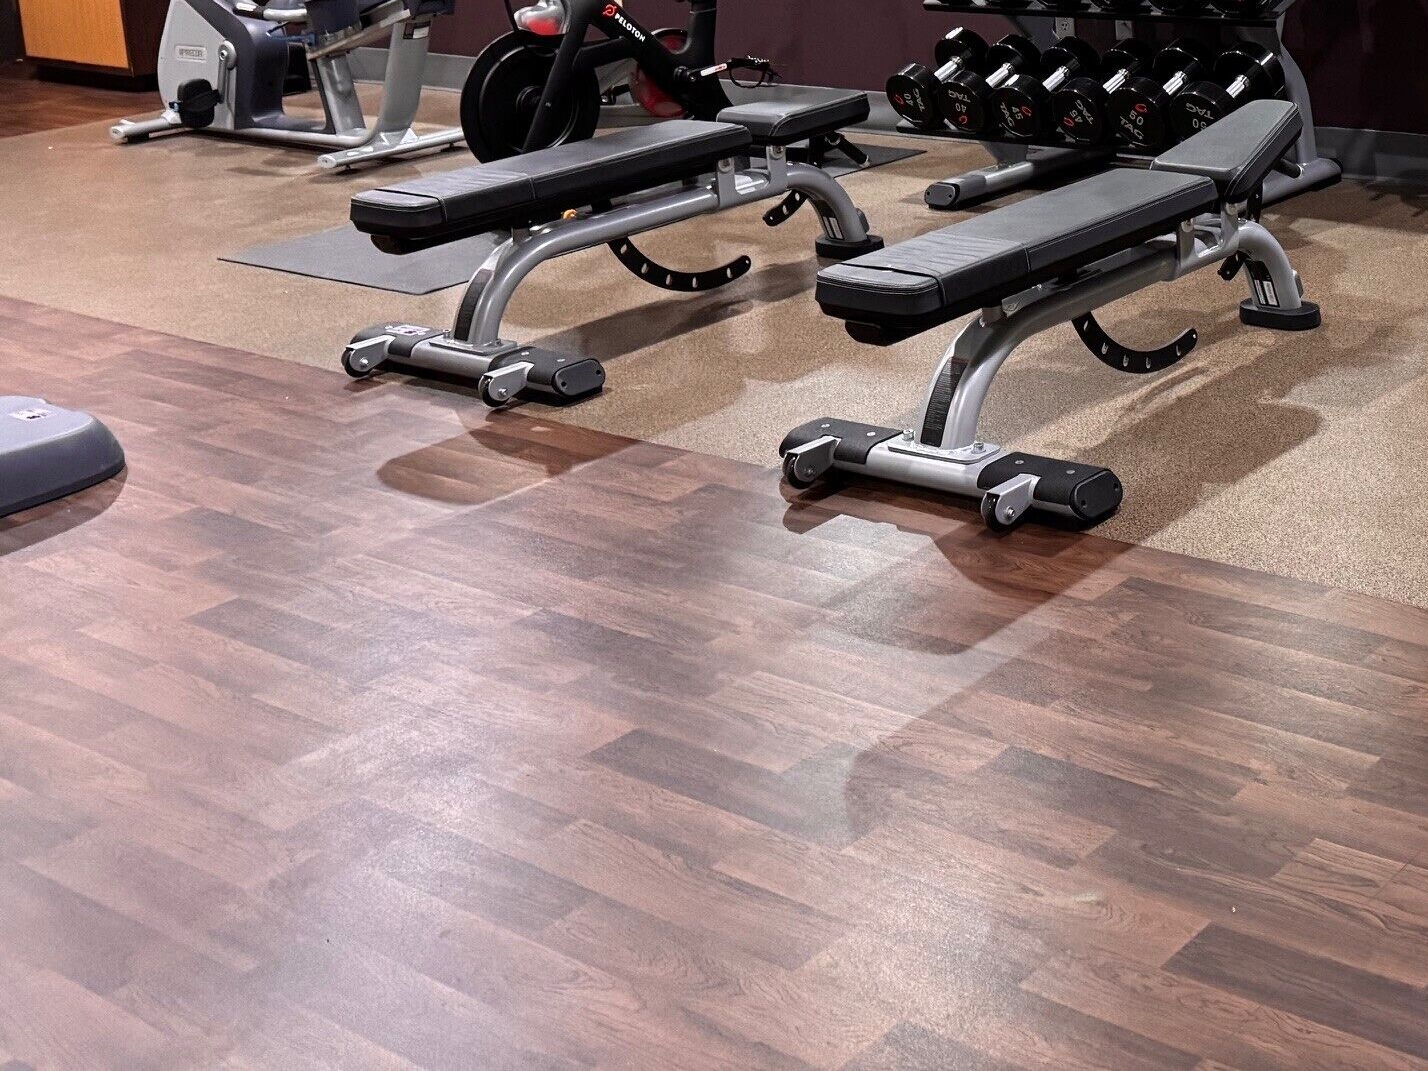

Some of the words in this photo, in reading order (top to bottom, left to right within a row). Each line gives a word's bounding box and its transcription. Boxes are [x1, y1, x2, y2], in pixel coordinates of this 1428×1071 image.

[614, 13, 646, 43] PELOTON
[904, 94, 914, 107] 40
[913, 88, 925, 112] TAG
[948, 90, 971, 103] TAG
[955, 103, 967, 113] 40
[1001, 102, 1016, 128] TAG
[1012, 106, 1024, 120] 45
[1069, 109, 1084, 123] 45
[1075, 99, 1094, 125] TAG
[1185, 102, 1214, 120] TAG
[1129, 110, 1144, 126] 50
[1120, 115, 1144, 140] TAG
